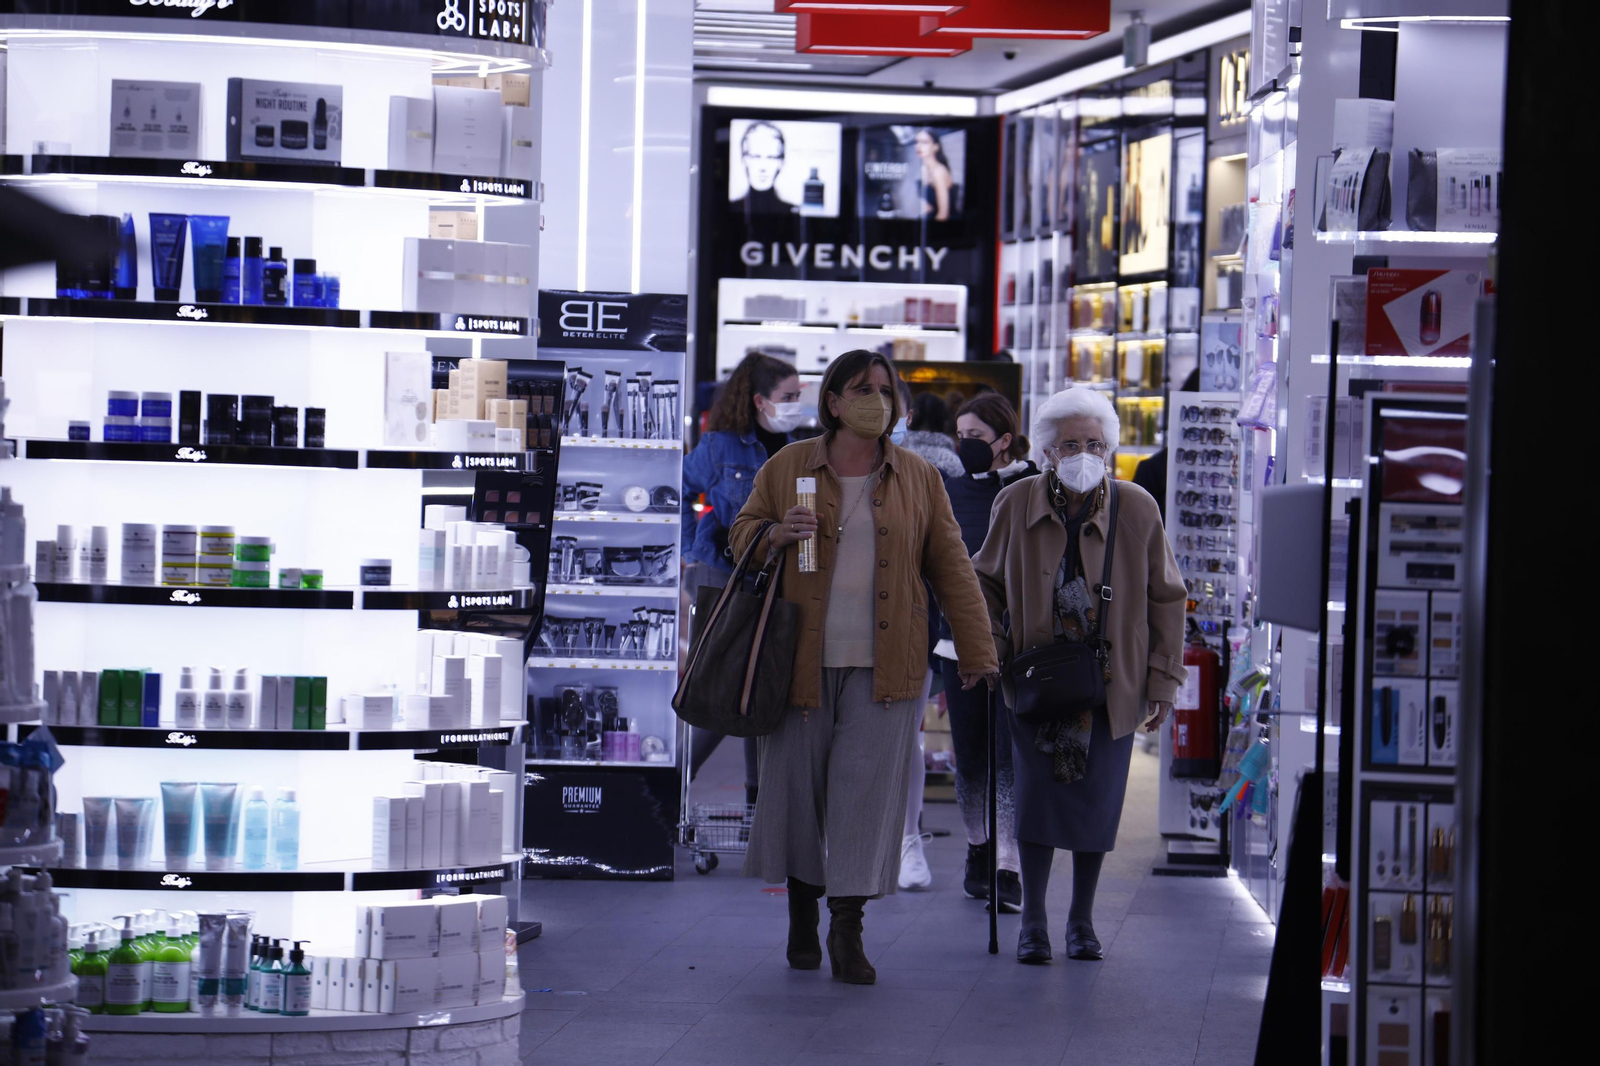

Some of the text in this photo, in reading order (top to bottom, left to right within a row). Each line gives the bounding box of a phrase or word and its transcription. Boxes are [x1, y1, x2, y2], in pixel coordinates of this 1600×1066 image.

[255, 97, 307, 113] NIGHT ROUTINE
[477, 181, 503, 193] SPOTS
[740, 240, 949, 272] GIVENCHY
[473, 319, 499, 330] SPOTS
[469, 456, 495, 467] SPOTS
[465, 596, 492, 606] SPOTS
[562, 786, 603, 804] PREMIUM
